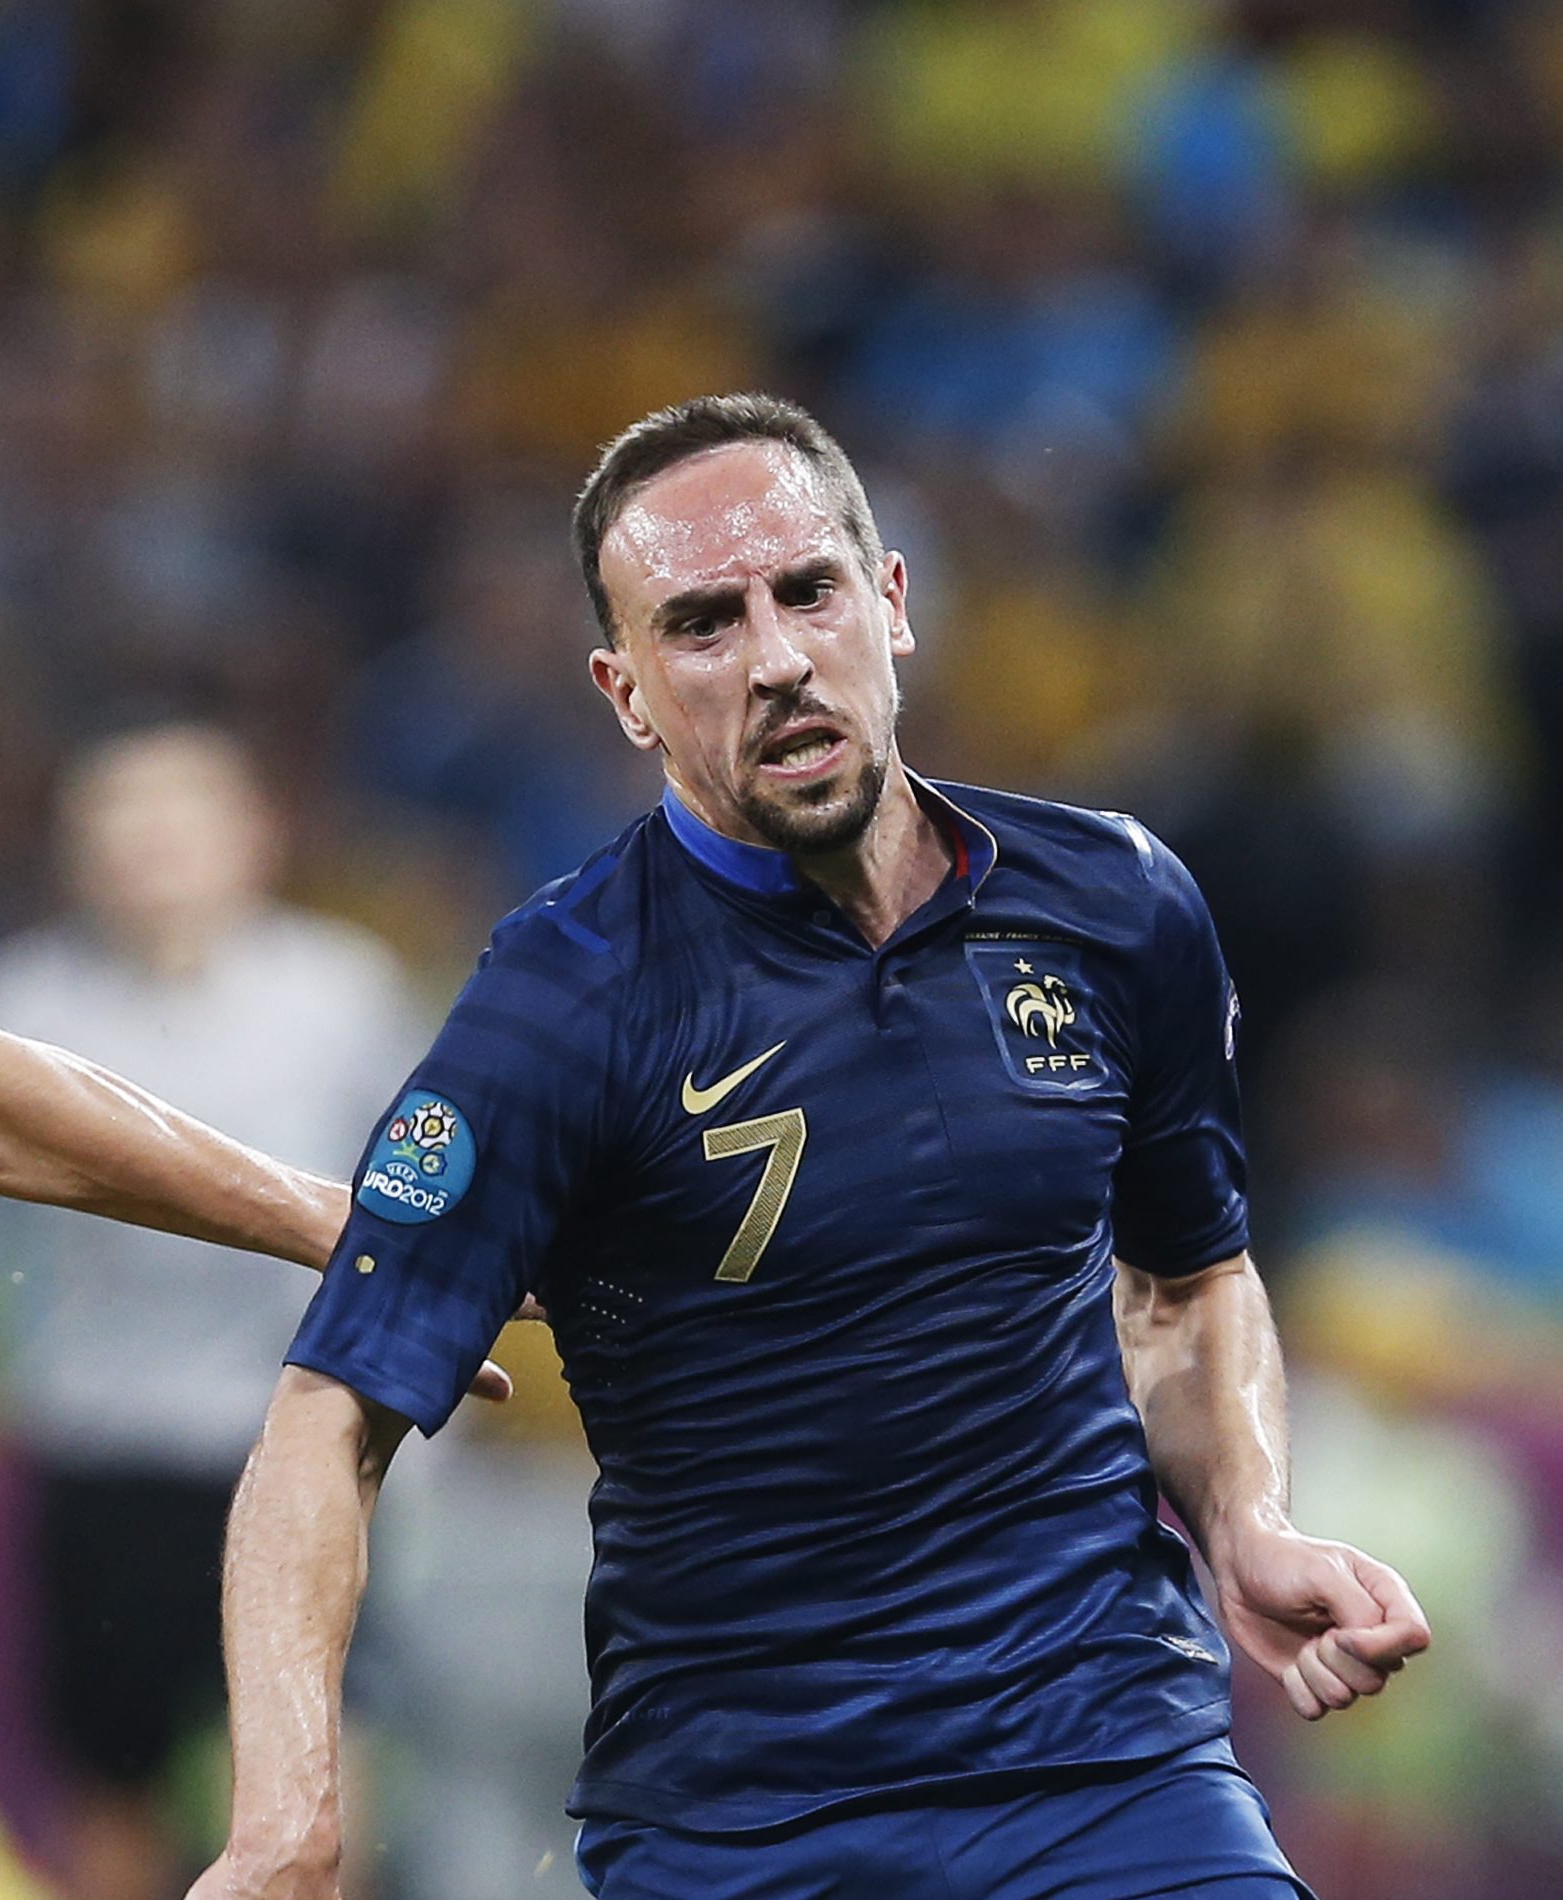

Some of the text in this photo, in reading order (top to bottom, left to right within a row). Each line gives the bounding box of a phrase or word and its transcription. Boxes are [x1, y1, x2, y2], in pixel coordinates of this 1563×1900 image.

[1025, 1054, 1091, 1074] FFF
[364, 1170, 445, 1216] URO2012
[702, 1107, 807, 1282] 7
